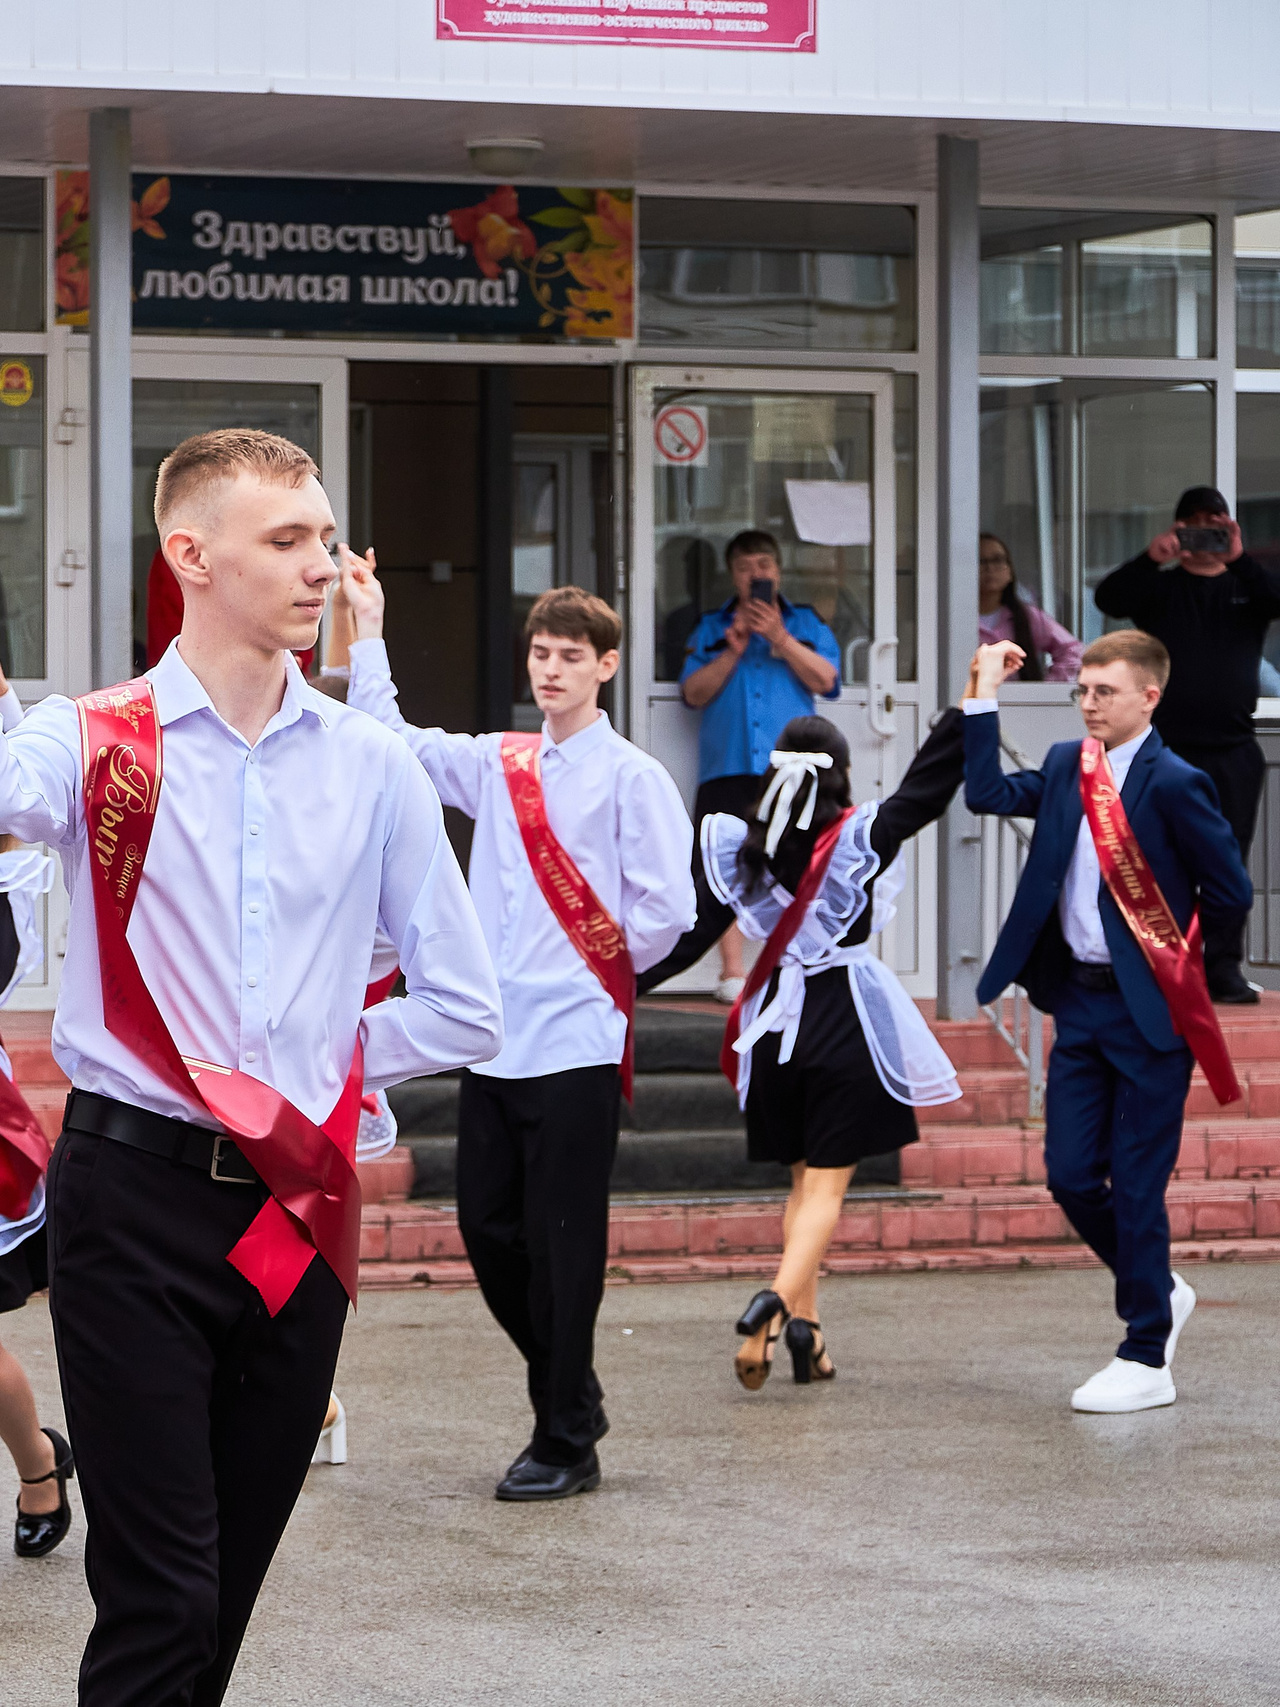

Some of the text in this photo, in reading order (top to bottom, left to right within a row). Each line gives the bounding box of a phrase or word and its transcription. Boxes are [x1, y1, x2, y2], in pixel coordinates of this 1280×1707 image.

[191, 209, 467, 263] Здравствуй,
[139, 262, 519, 307] любимая школа!
[94, 744, 150, 881] Вып
[116, 843, 144, 899] Зайцев
[575, 911, 626, 961] 2025
